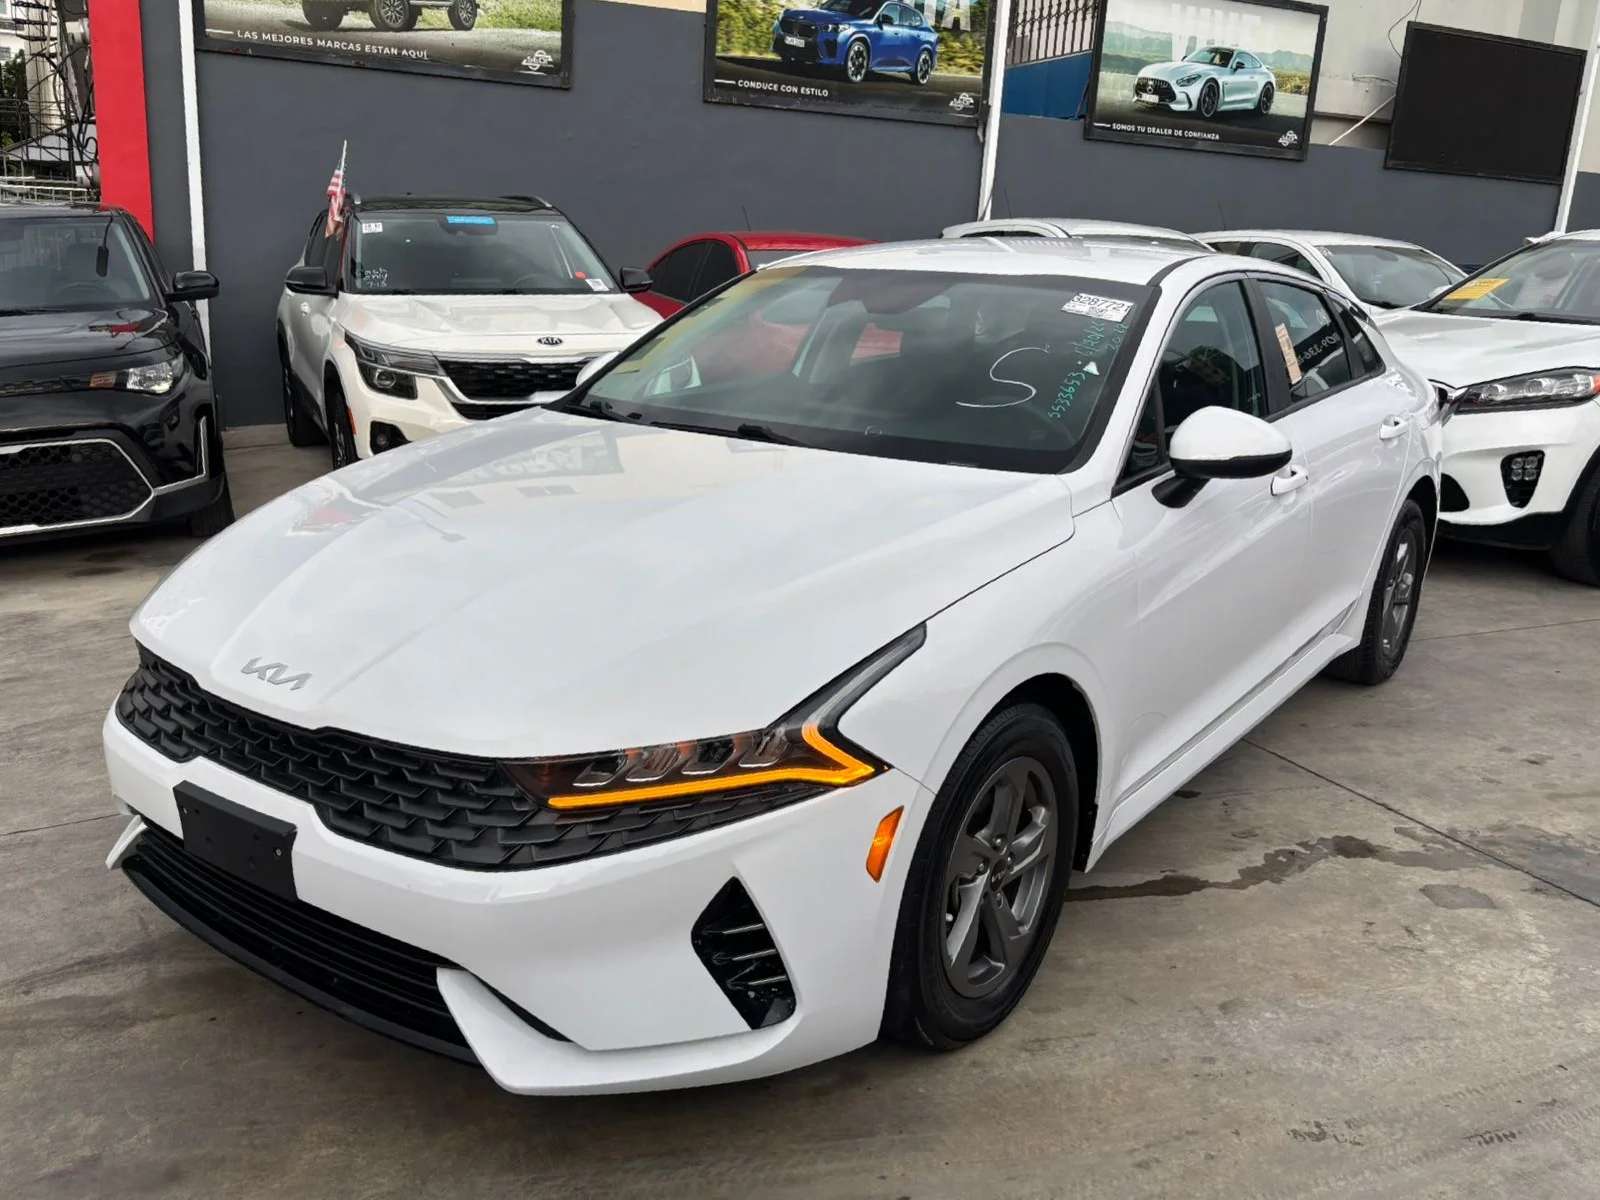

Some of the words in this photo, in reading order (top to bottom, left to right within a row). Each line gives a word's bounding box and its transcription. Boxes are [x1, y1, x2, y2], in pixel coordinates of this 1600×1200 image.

[237, 30, 258, 40] LAS
[262, 33, 313, 46] MEJORES
[317, 39, 361, 52] MARCAS
[365, 44, 398, 56] ESTAN
[738, 79, 779, 92] CONDUCE
[780, 84, 799, 94] CON
[801, 86, 829, 97] ESTILO
[1112, 122, 1136, 132] SOMOS
[1137, 125, 1146, 133] TU
[1147, 126, 1172, 136] DEALER
[1174, 129, 1183, 137] DE
[1184, 130, 1220, 141] CONFIANZA
